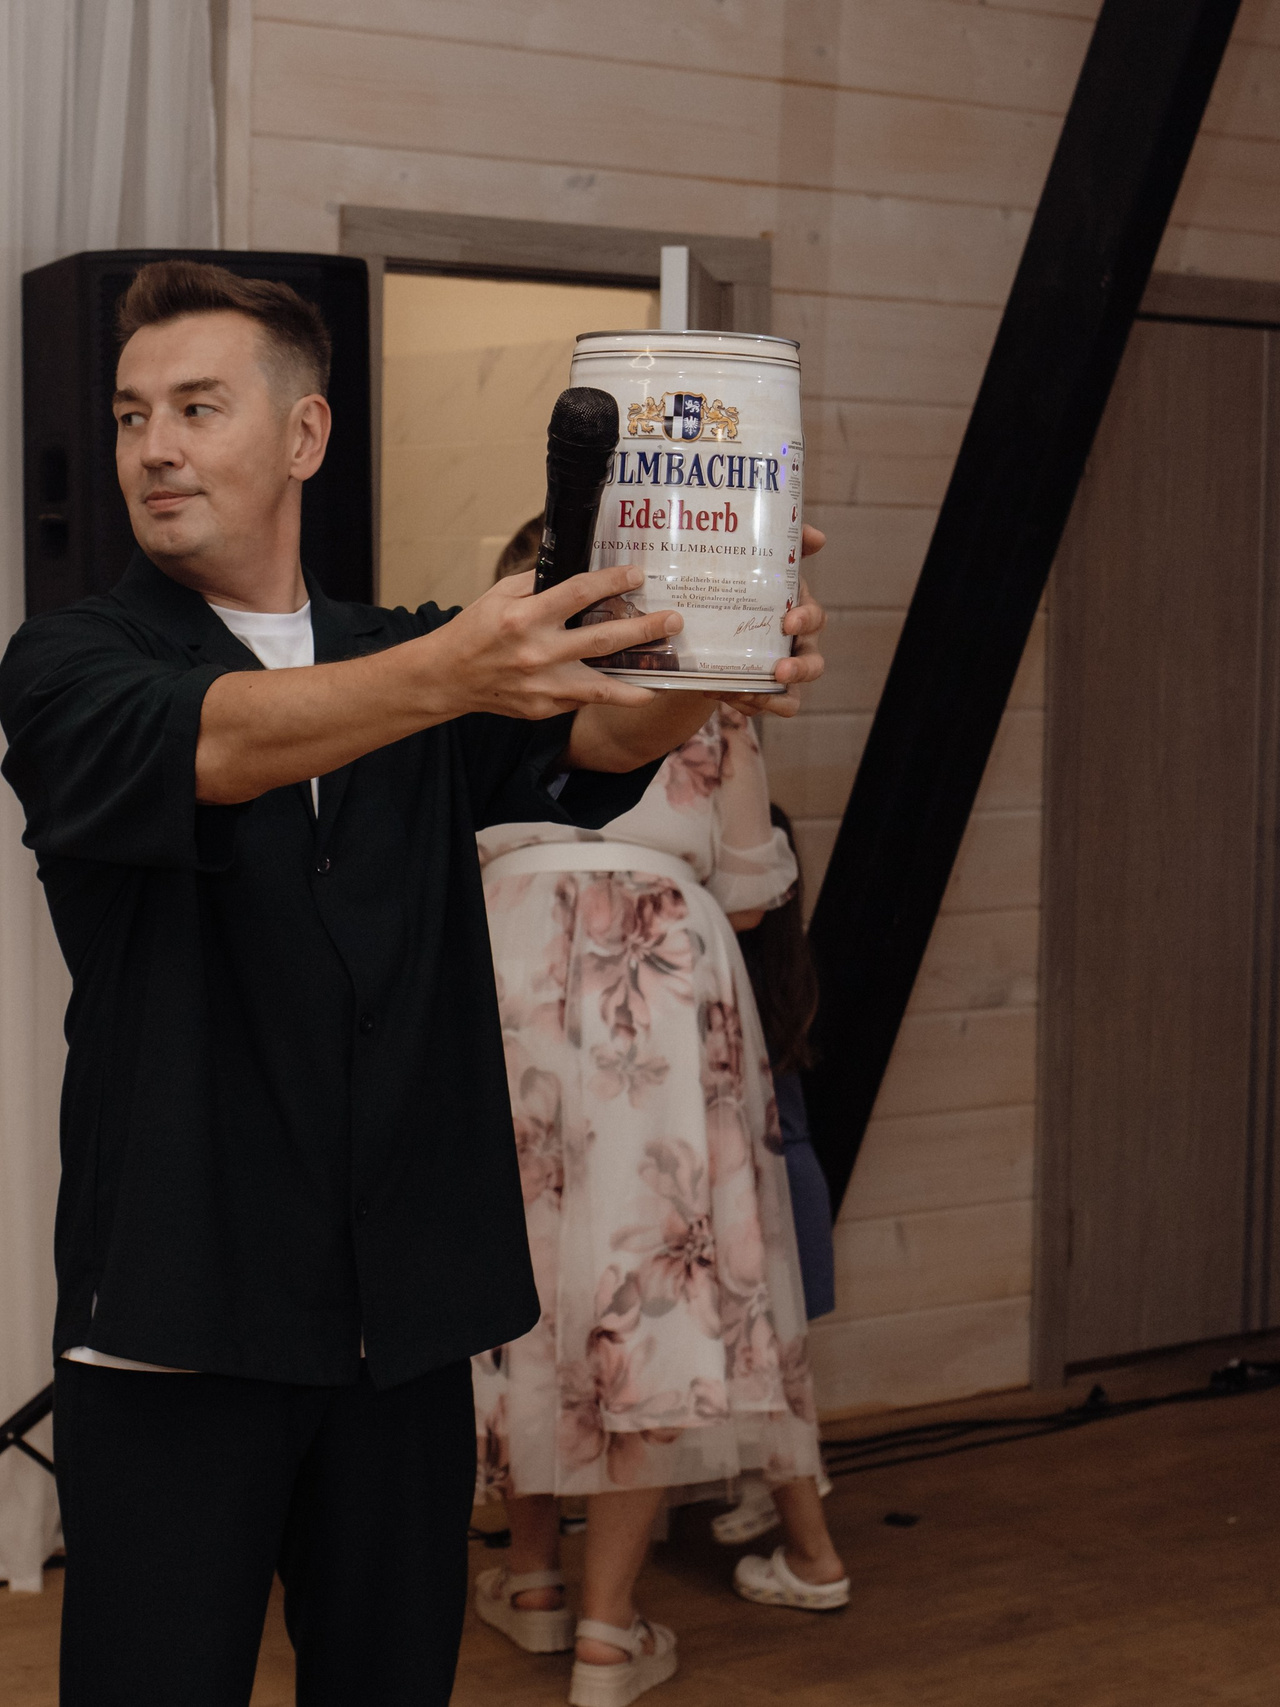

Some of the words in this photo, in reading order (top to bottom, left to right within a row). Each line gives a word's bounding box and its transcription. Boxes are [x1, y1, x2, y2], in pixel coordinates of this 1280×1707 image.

[606, 451, 780, 491] LMBACHER
[618, 498, 738, 533] Edelherb
[593, 540, 655, 551] GENDÄRES
[661, 542, 747, 556] KULMBACHER
[680, 575, 710, 583] Edelherb
[689, 593, 735, 603] Originalrezept
[686, 602, 722, 611] Erinnerung
